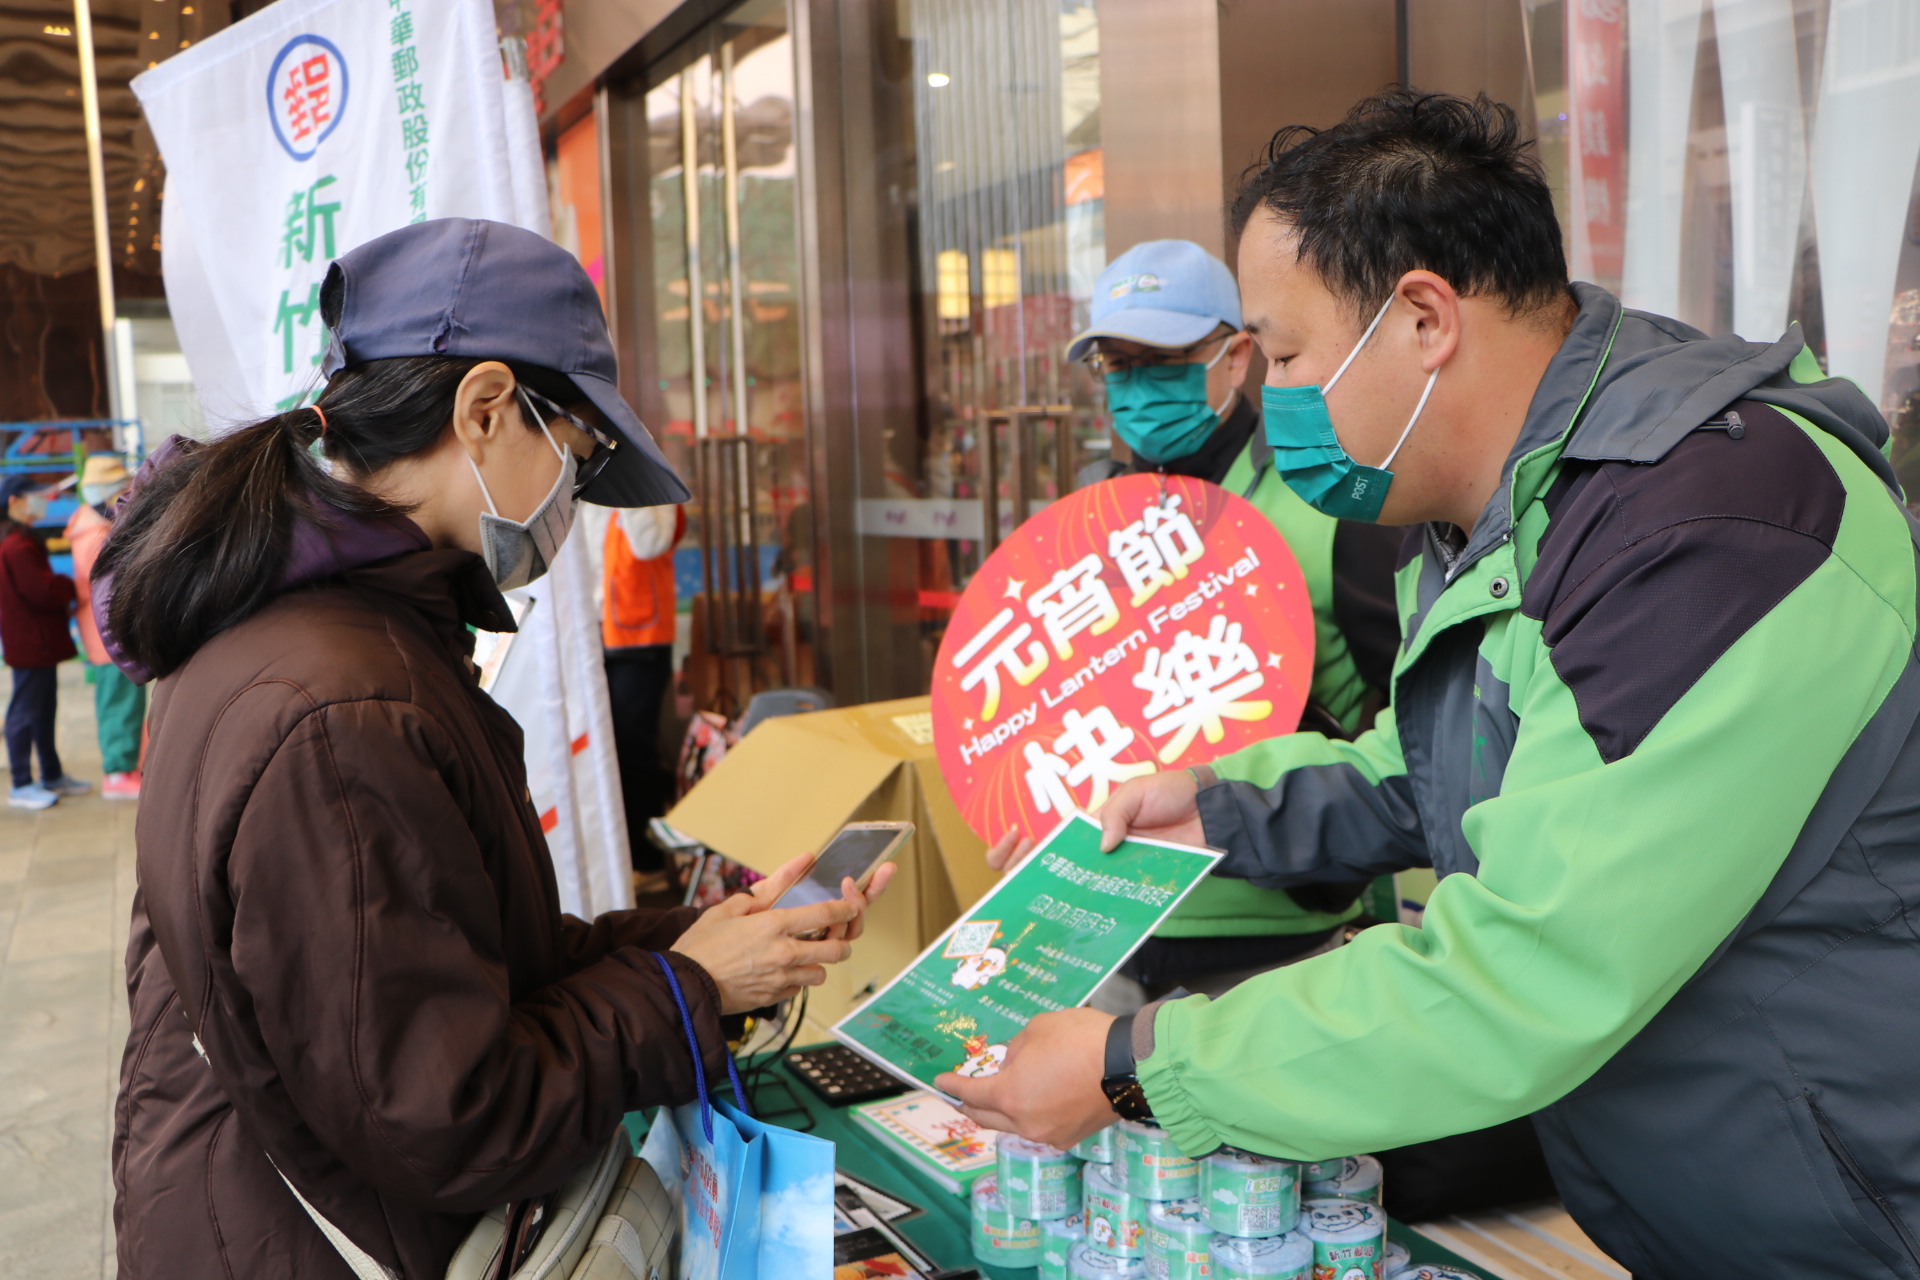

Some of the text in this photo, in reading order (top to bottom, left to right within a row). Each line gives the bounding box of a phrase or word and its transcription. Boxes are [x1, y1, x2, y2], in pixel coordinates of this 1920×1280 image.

[273, 174, 341, 411] 新竹
[1351, 476, 1369, 500] POST
[952, 493, 1206, 722] 元宵節
[958, 546, 1261, 766] Happy Lantern Festival
[1023, 614, 1273, 818] 快樂
[1328, 1245, 1375, 1262] 新竹郵局
